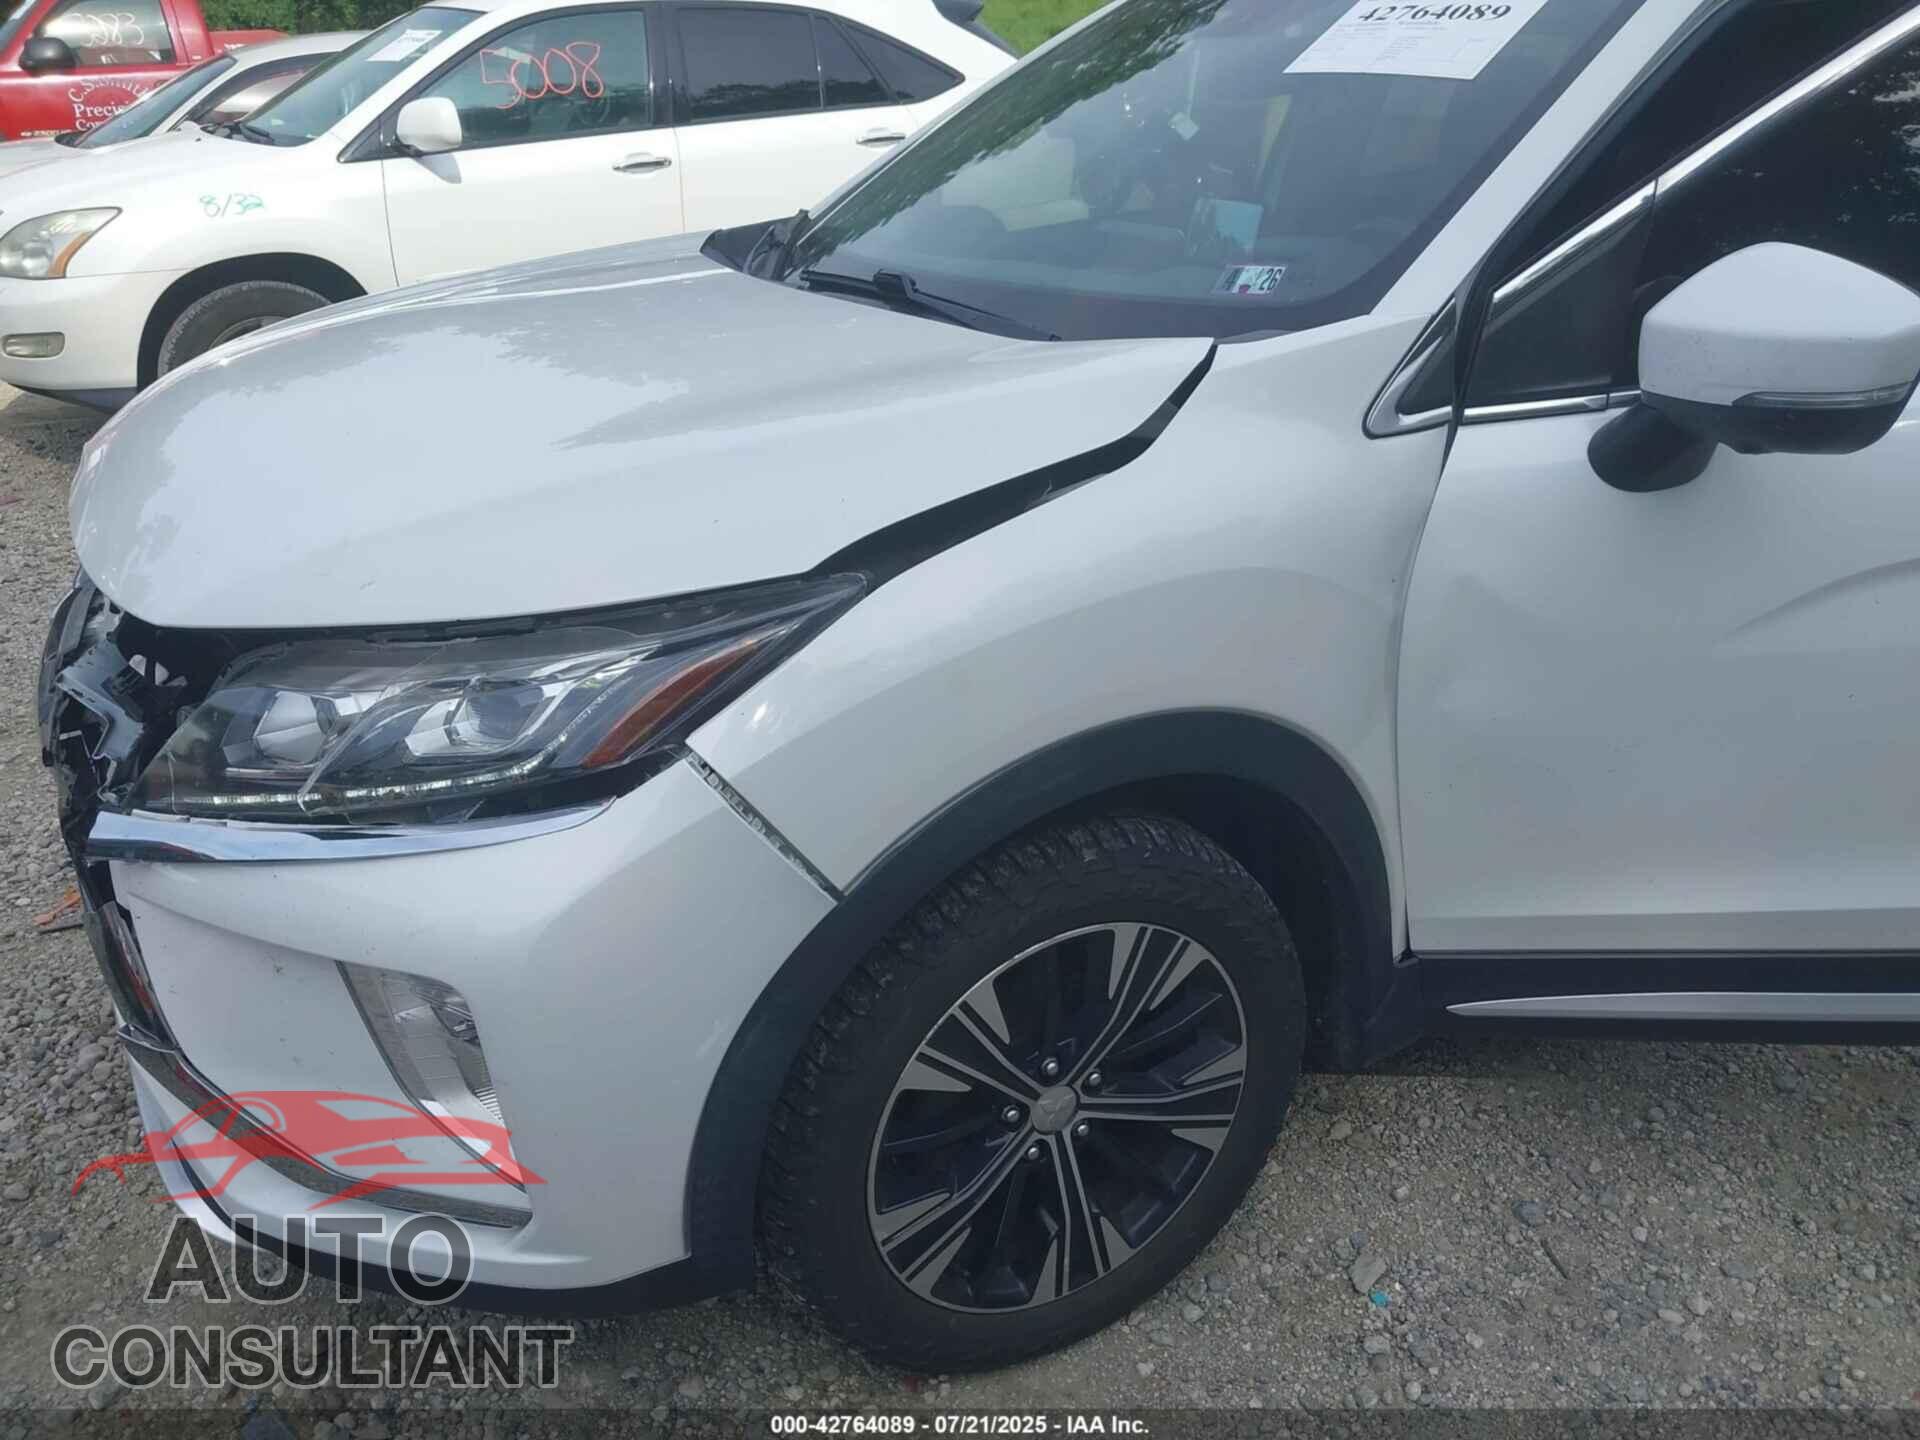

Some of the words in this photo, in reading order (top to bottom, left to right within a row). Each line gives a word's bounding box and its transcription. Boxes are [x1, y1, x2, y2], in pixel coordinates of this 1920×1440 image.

[1358, 4, 1512, 22] 42764089
[480, 41, 604, 109] 5008
[1259, 268, 1282, 291] 26
